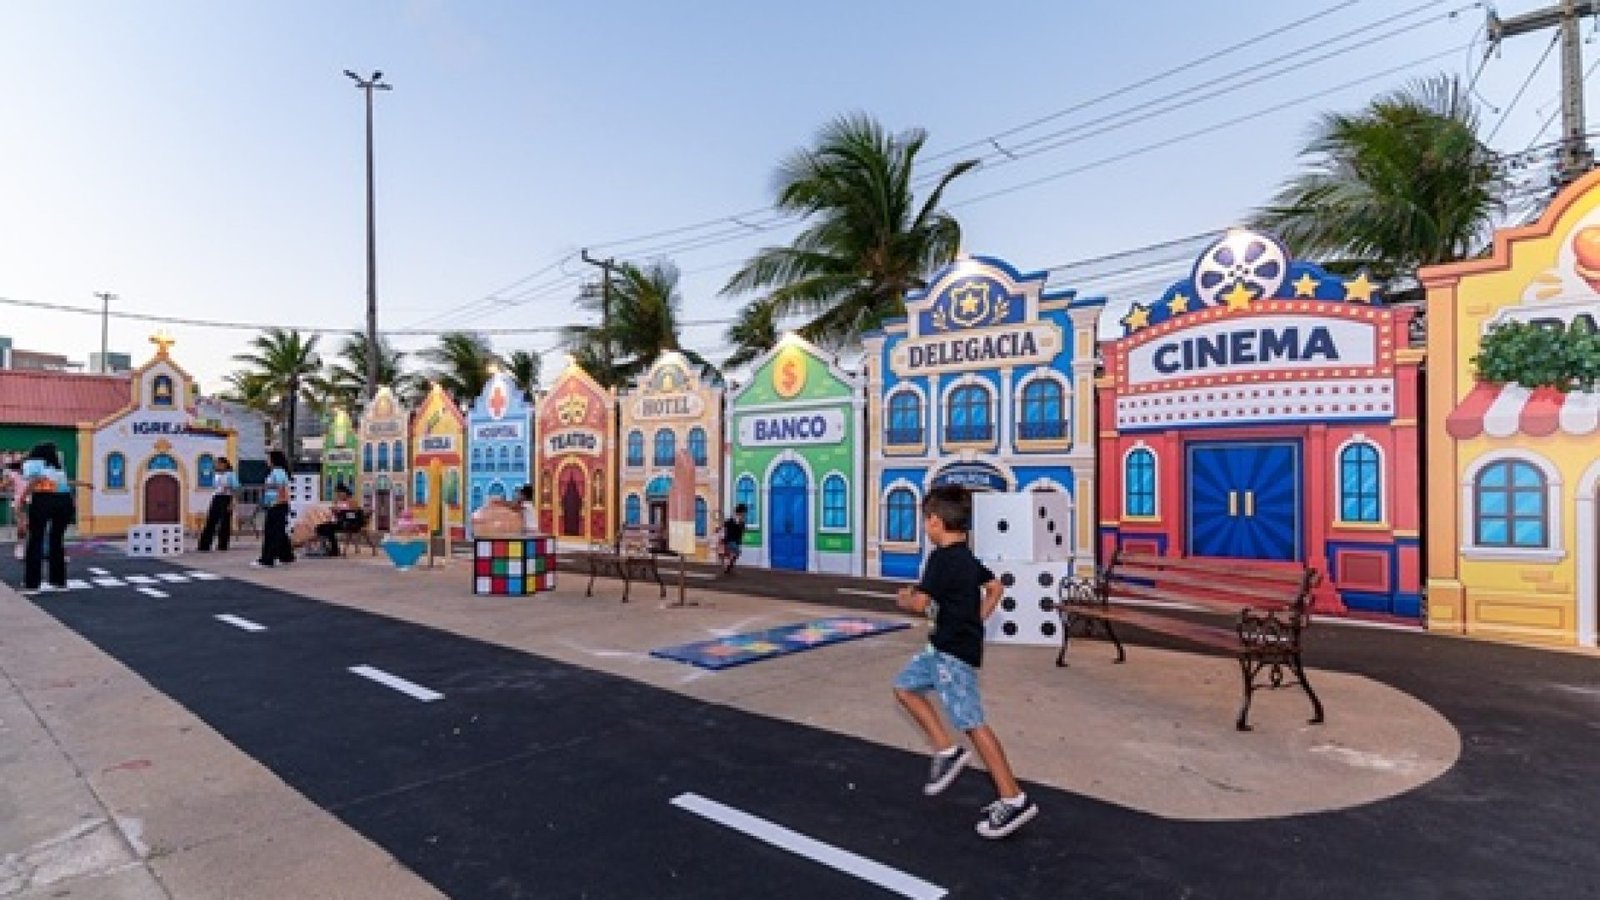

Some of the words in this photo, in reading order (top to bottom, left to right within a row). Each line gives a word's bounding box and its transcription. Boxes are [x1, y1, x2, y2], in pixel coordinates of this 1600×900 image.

[909, 331, 1037, 368] DELEGACIA
[1153, 325, 1340, 374] CINEMA
[643, 397, 691, 416] HOTEL
[551, 432, 597, 450] TEATRO
[754, 416, 827, 441] BANCO
